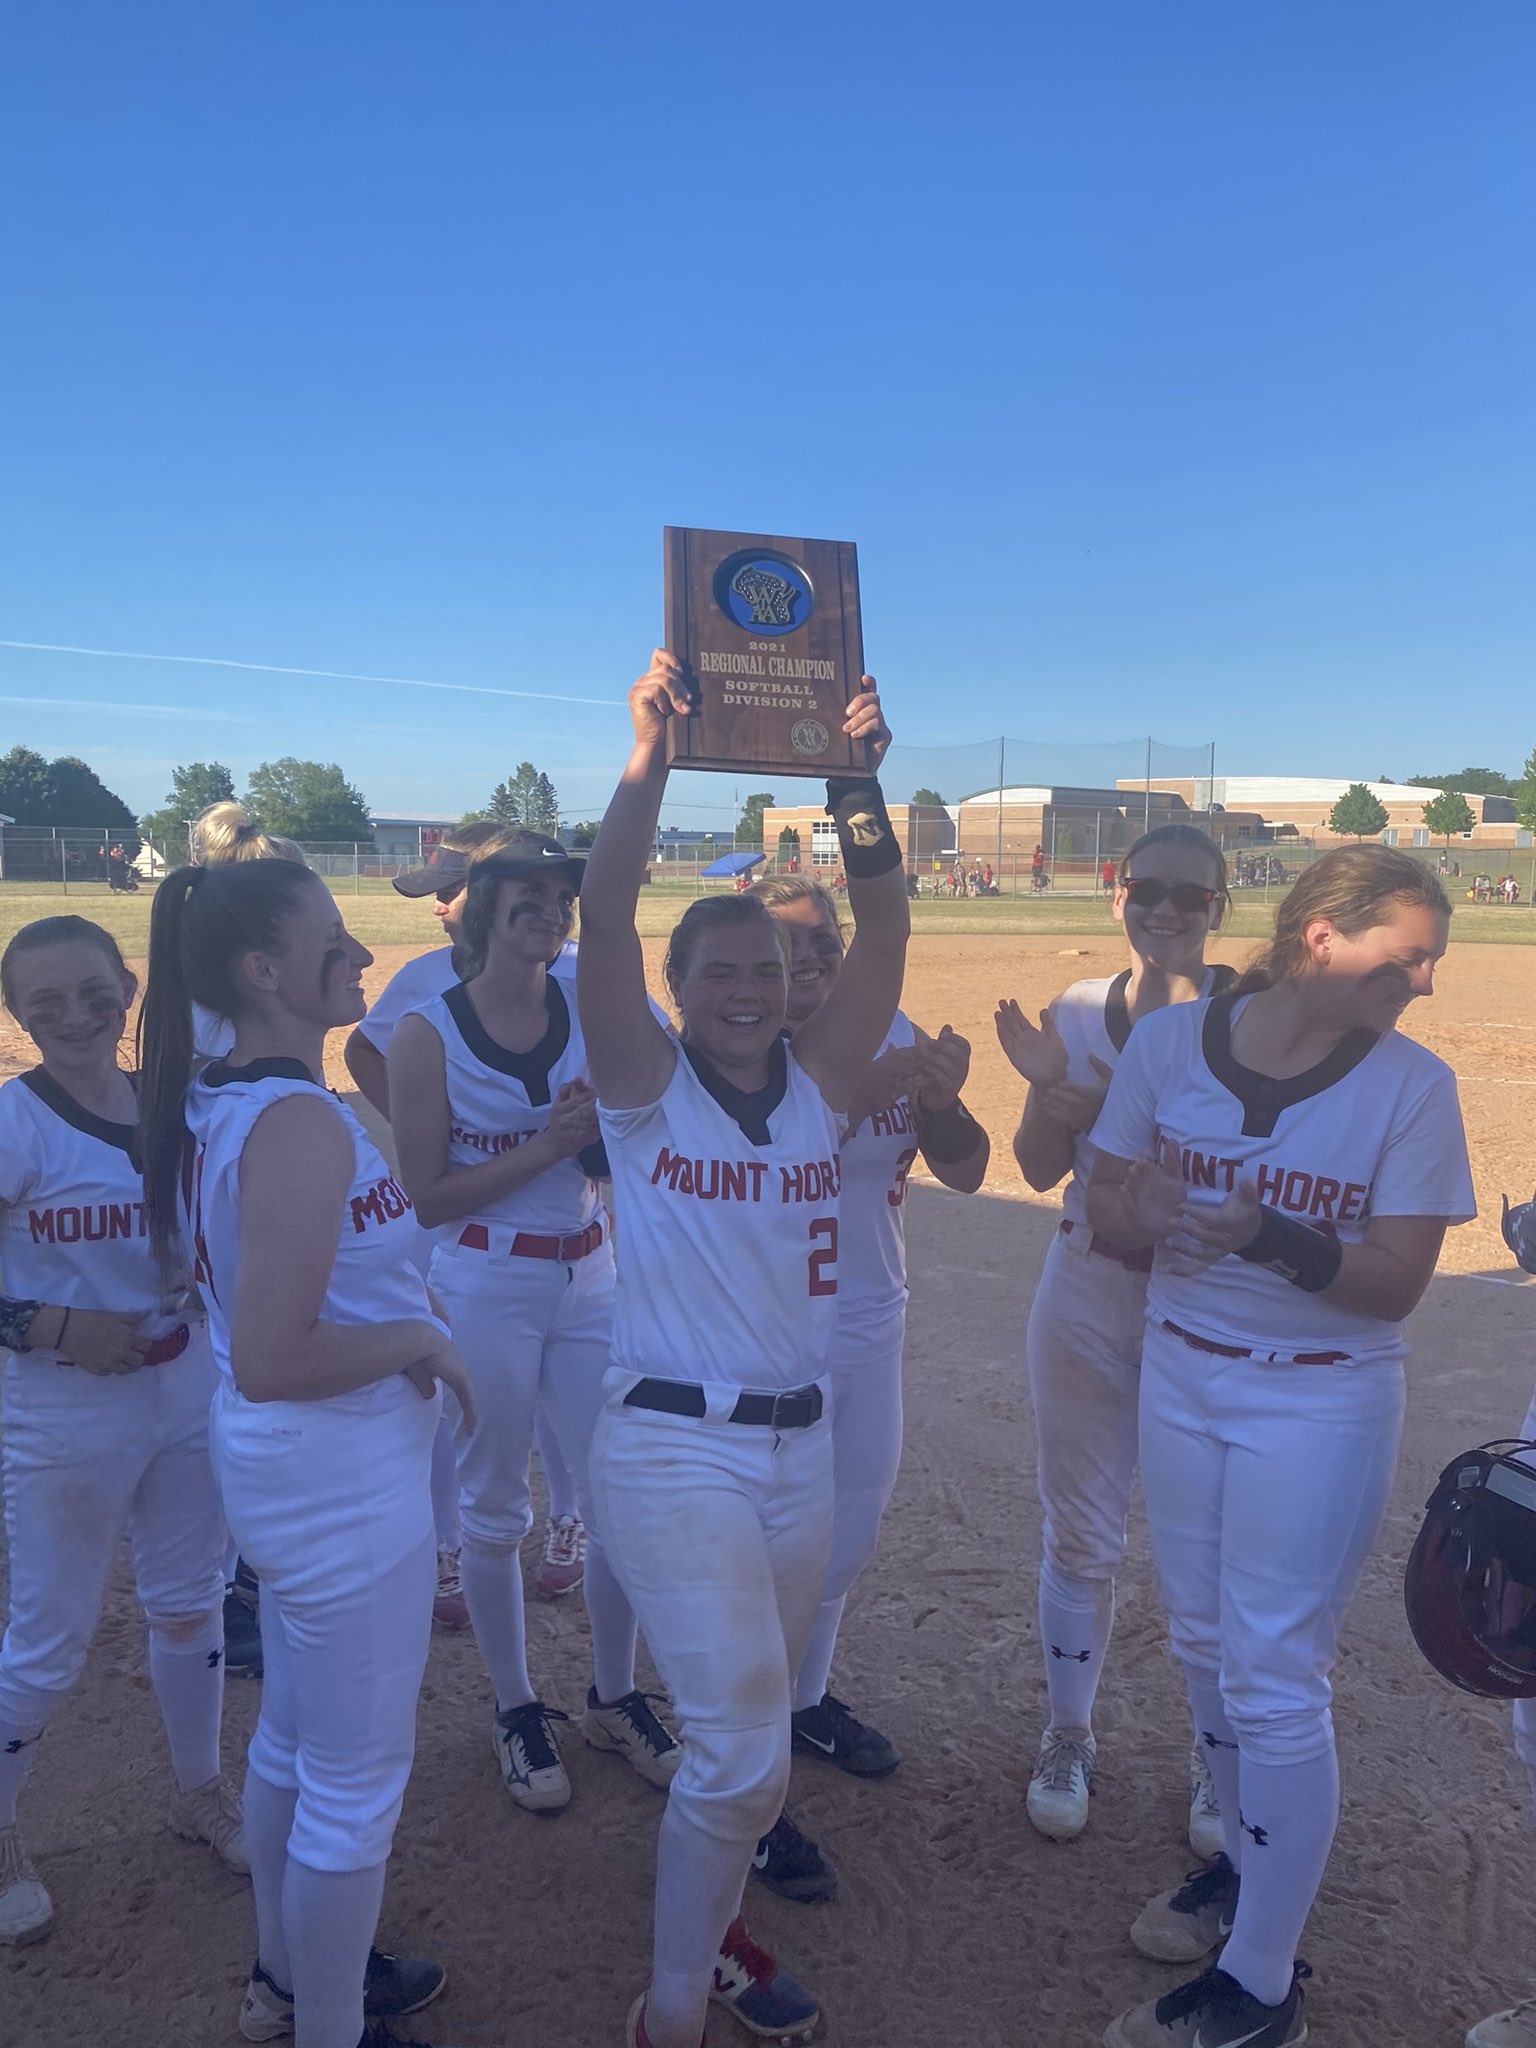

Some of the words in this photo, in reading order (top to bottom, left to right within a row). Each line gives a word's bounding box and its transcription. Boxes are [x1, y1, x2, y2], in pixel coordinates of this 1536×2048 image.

[749, 642, 786, 652] 2021
[700, 652, 766, 675] REGIONAL
[769, 657, 835, 680] CHAMPION
[723, 694, 802, 708] DIVISION
[808, 700, 818, 709] 2
[725, 680, 814, 695] SOFTBALL
[652, 1147, 769, 1202] MOUNT
[1258, 1164, 1372, 1221] HORE
[29, 1202, 148, 1244] MOUNT
[808, 1216, 839, 1297] 2
